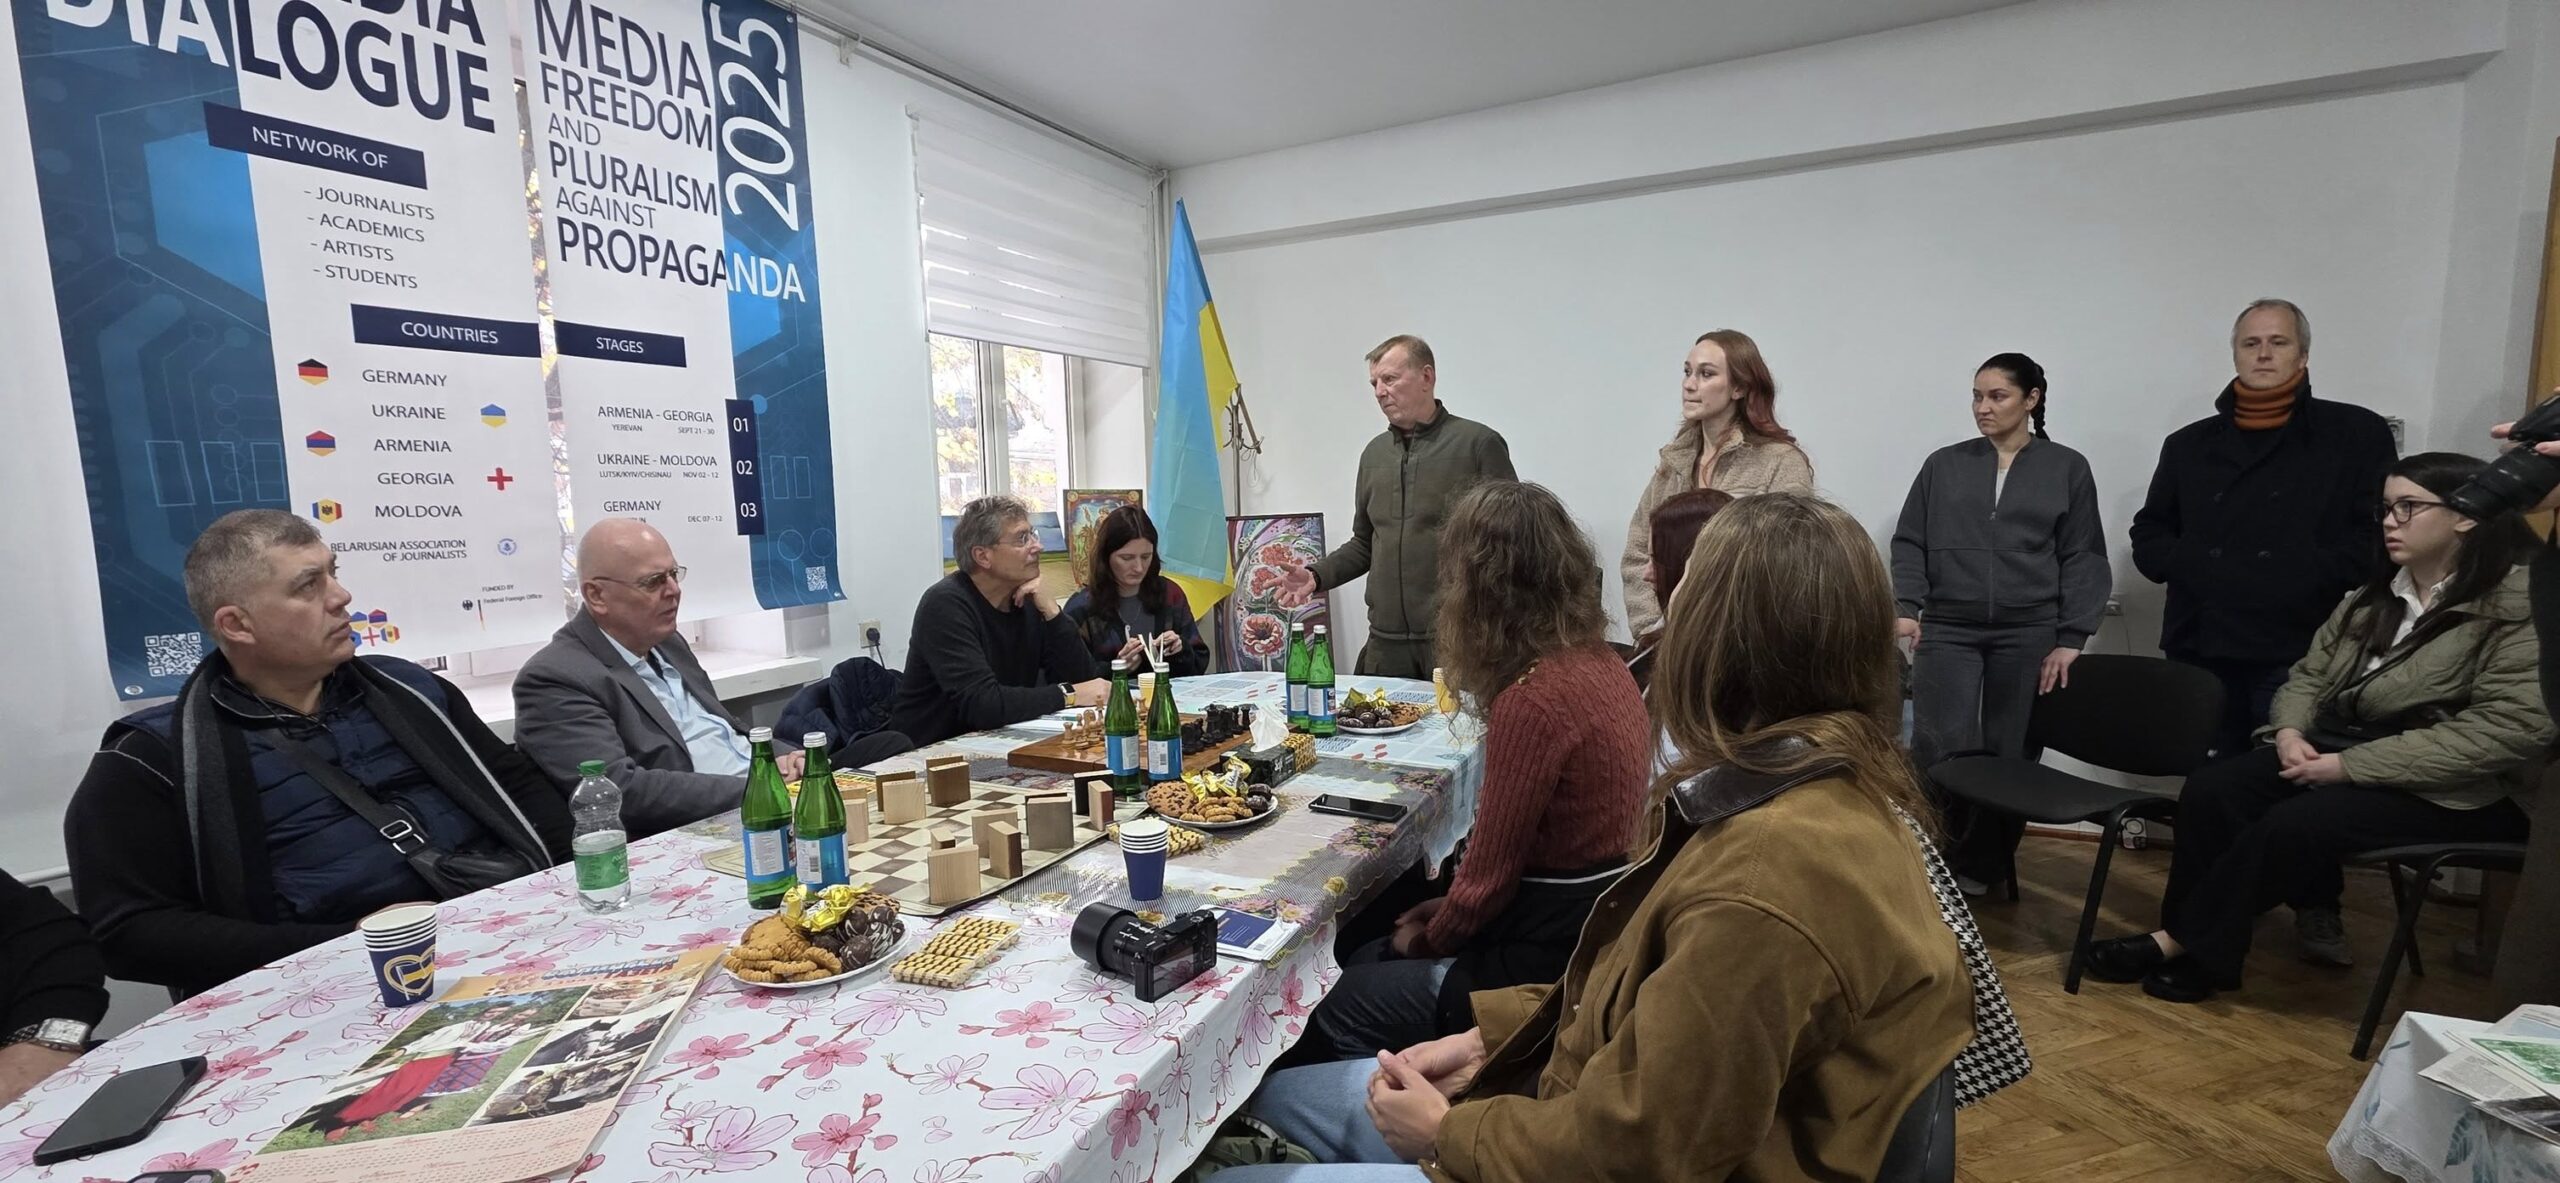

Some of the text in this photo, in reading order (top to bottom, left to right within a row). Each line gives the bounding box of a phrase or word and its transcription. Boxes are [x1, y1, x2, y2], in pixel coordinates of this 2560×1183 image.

[534, 0, 711, 108] MEDIA
[540, 61, 713, 152] FREEDOM
[709, 2, 799, 231] 2025
[548, 112, 601, 146] AND
[252, 126, 389, 169] NETWORK OF
[550, 142, 718, 216] PLURALISM
[316, 187, 435, 221] JOURNALISTS
[556, 186, 656, 228] AGAINST
[320, 213, 425, 242] ACADEMICS
[323, 239, 394, 261] ARTISTS
[557, 216, 806, 302] PROPAGANDA
[325, 265, 418, 289] STUDENTS
[401, 321, 499, 344] COUNTRIES
[596, 337, 644, 353] STAGES
[362, 369, 448, 387] GERMANY
[372, 404, 446, 420] UKRAINE
[598, 406, 653, 419] ARMENIA
[663, 410, 714, 423] GEORGIA
[612, 424, 643, 432] YEREVAN
[678, 426, 693, 434] SEPT
[733, 418, 749, 432] 01
[373, 439, 452, 453] ARMENIA
[597, 454, 650, 465] UKRAINE
[660, 455, 717, 466] MOLDOVA
[736, 460, 753, 475] 02
[377, 472, 454, 485] GEORGIA
[375, 505, 463, 518] MOLDOVA
[603, 501, 661, 512] GERMANY
[740, 503, 757, 517] 03
[330, 539, 466, 552] BELARUSIAN ASSOCIATION
[383, 550, 467, 562] OF JOURNALISTS
